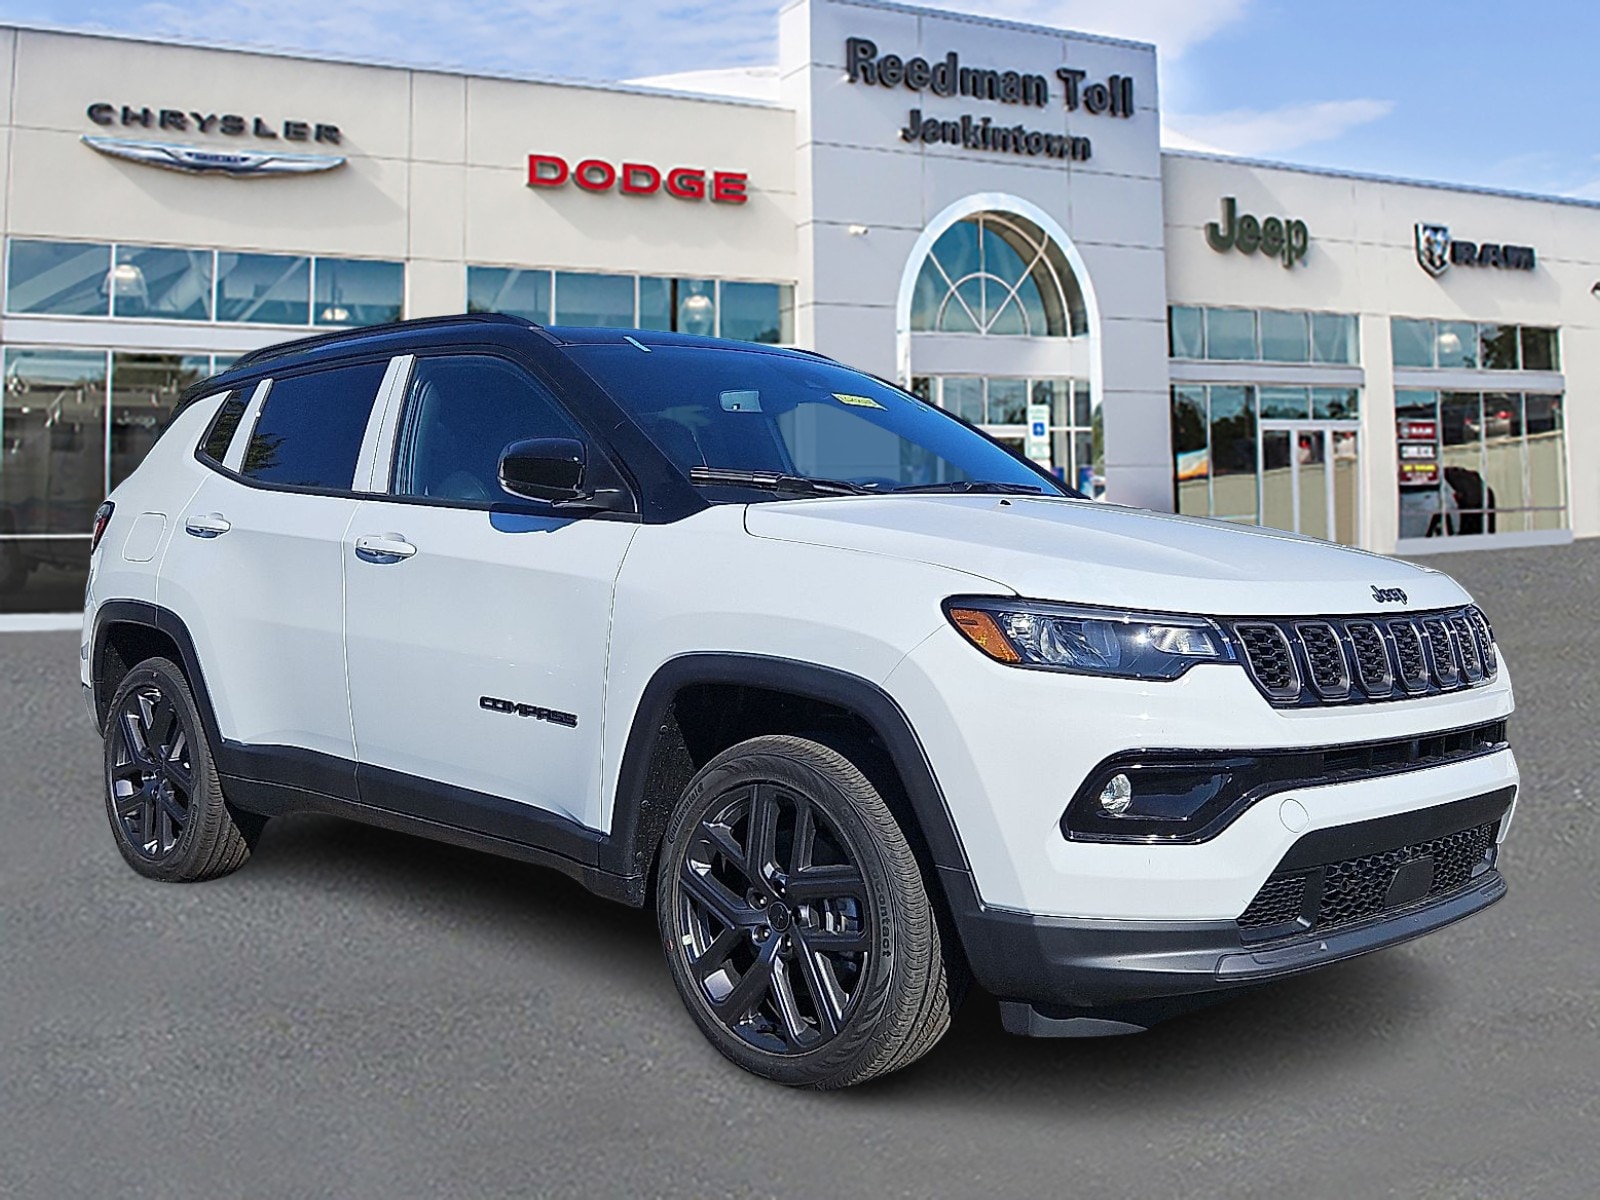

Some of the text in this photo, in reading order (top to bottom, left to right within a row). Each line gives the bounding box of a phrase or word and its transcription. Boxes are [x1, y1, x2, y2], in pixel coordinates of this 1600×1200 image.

[845, 36, 1134, 118] Reedman Toll
[86, 102, 342, 145] CHRYSLER
[900, 109, 1092, 161] Jenkintown
[526, 153, 748, 203] DODGE
[1204, 196, 1308, 269] Jeep
[1450, 240, 1535, 271] RAM
[1370, 584, 1408, 605] Jeep
[479, 696, 578, 729] COMPASS
